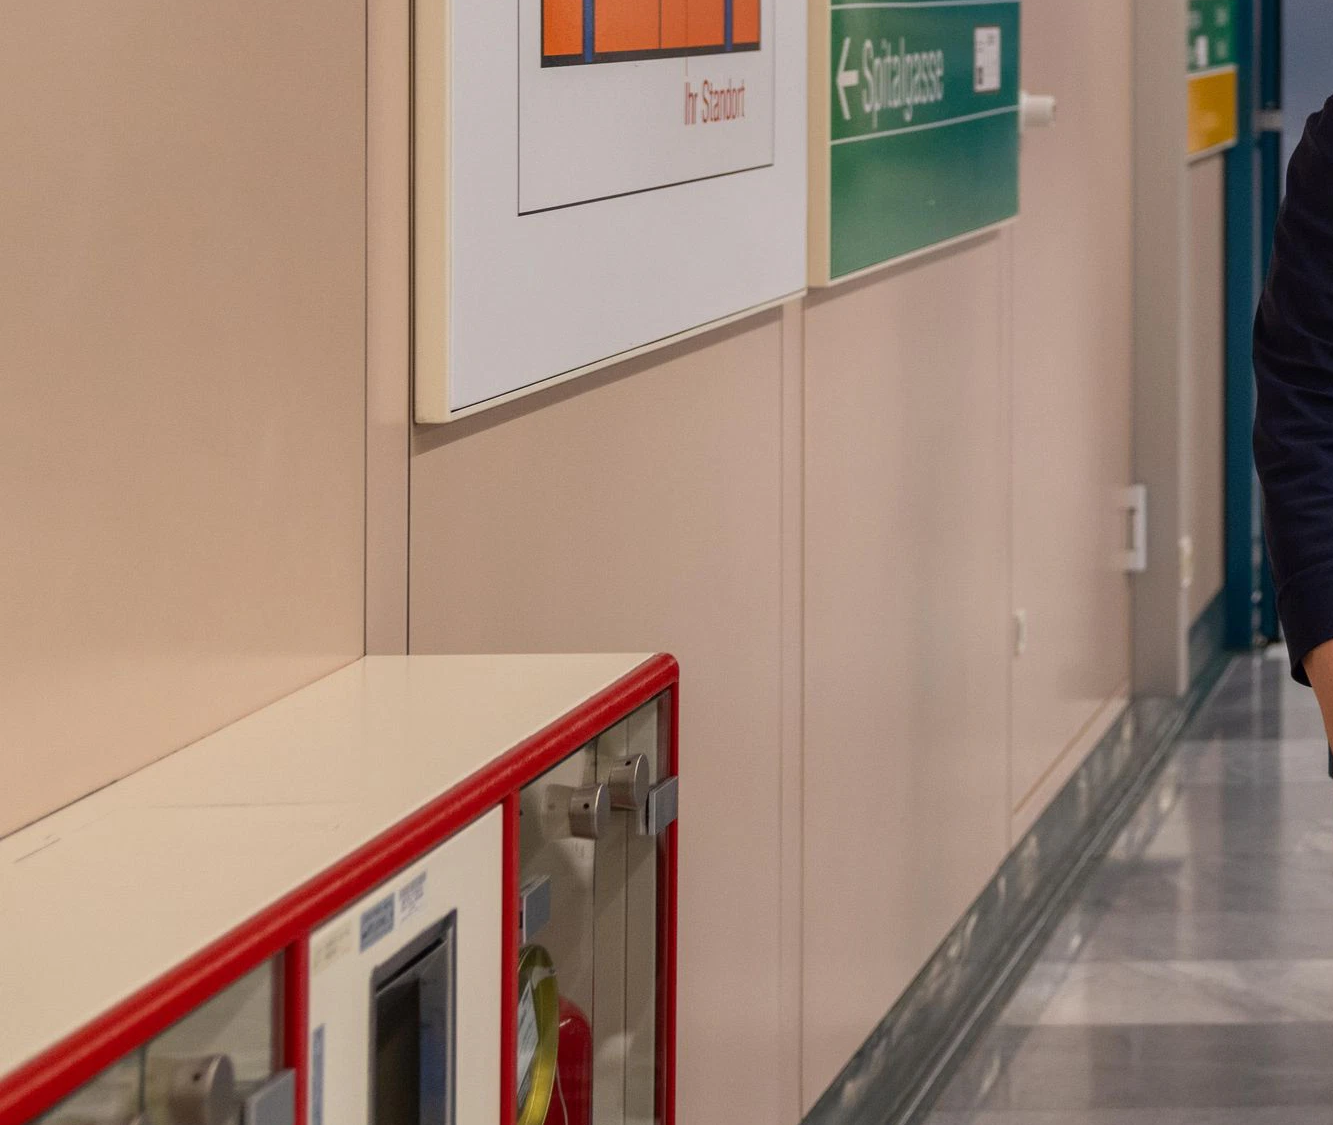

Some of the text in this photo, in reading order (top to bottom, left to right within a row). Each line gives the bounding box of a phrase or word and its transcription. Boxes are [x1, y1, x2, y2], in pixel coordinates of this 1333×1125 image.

[685, 78, 745, 125] Ihr Standort
[862, 35, 945, 131] Spitalgasse
